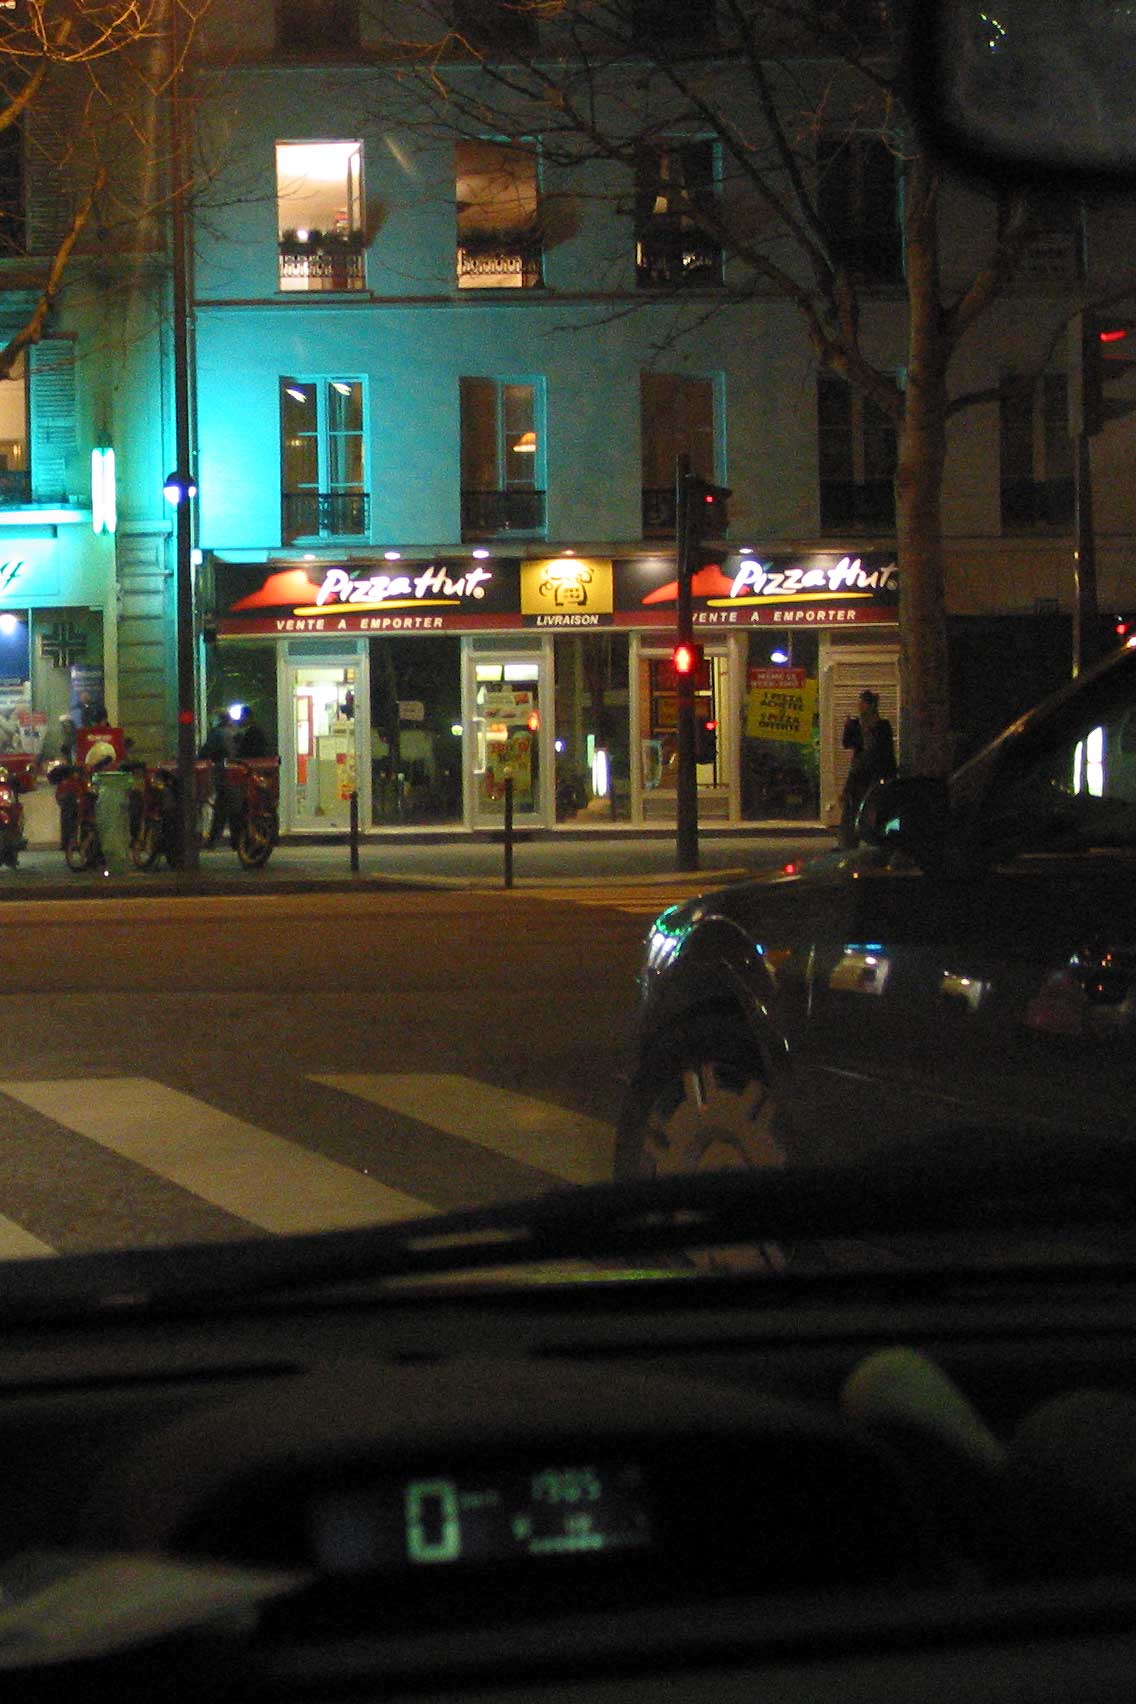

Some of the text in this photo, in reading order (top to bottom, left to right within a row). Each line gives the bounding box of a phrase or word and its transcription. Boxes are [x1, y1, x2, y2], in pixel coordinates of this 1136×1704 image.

[316, 565, 493, 606] Pizza Hut
[729, 556, 898, 598] Pizza Hut
[276, 617, 444, 631] VENTE A EMPORTER
[536, 614, 599, 626] LIVRAISON
[750, 611, 760, 622] A
[773, 609, 856, 622] EMPORTER
[405, 1477, 462, 1564] 0
